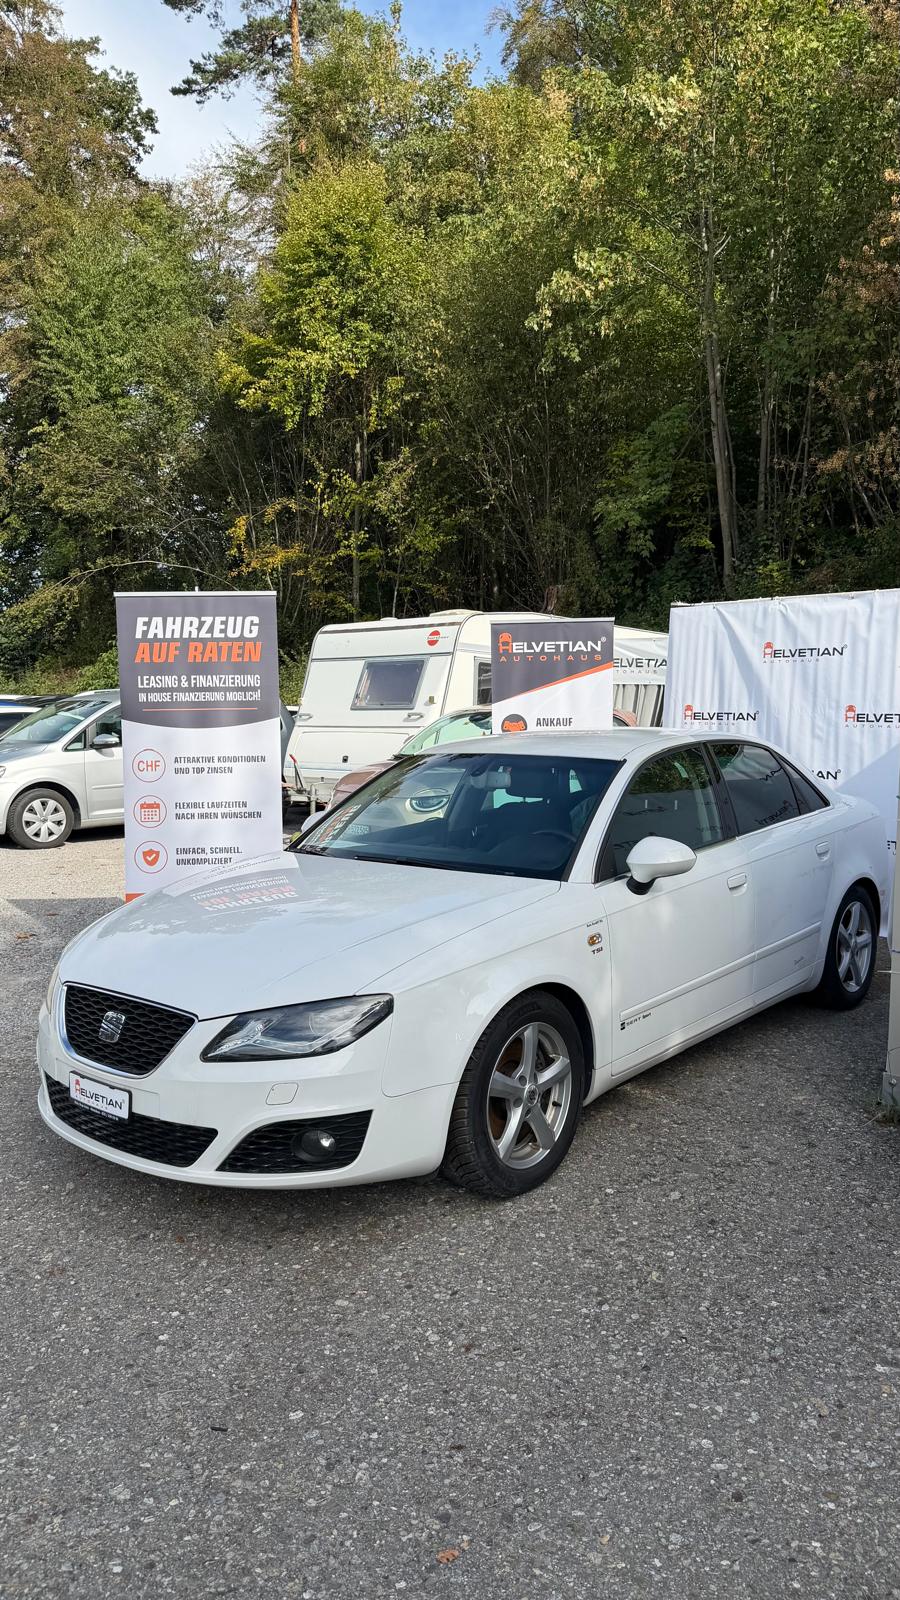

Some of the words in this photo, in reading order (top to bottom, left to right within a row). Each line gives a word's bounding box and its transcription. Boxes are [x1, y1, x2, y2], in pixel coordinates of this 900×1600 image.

[135, 616, 260, 639] FAHRZEUG
[134, 642, 181, 663] AUF
[187, 641, 262, 663] RATEN
[500, 655, 602, 663] AUTOHAUS
[137, 675, 179, 688] LEASING
[180, 675, 189, 688] &
[190, 674, 261, 688] FINANZIERUNG
[138, 692, 147, 703] IN
[148, 692, 172, 702] HOUSE
[173, 691, 225, 702] FINANZIERUNG
[536, 717, 574, 727] ANKAUF
[174, 756, 216, 764] ATTRAKTIVE
[217, 755, 266, 763] KONDITIONEN
[137, 760, 161, 772] CHF
[174, 767, 190, 775] UND
[192, 767, 206, 775] TOP
[206, 766, 233, 774] ZINSEN
[175, 801, 206, 810] FLEXIBLE
[207, 800, 248, 809] LAUFZEITEN
[175, 812, 196, 820] NACH
[197, 811, 219, 820] IHREN
[220, 809, 262, 819] WÜNSCHEN
[176, 847, 208, 856] EINFACH,
[176, 857, 233, 866] UNKOMPLIZIERT
[591, 946, 603, 955] TSI
